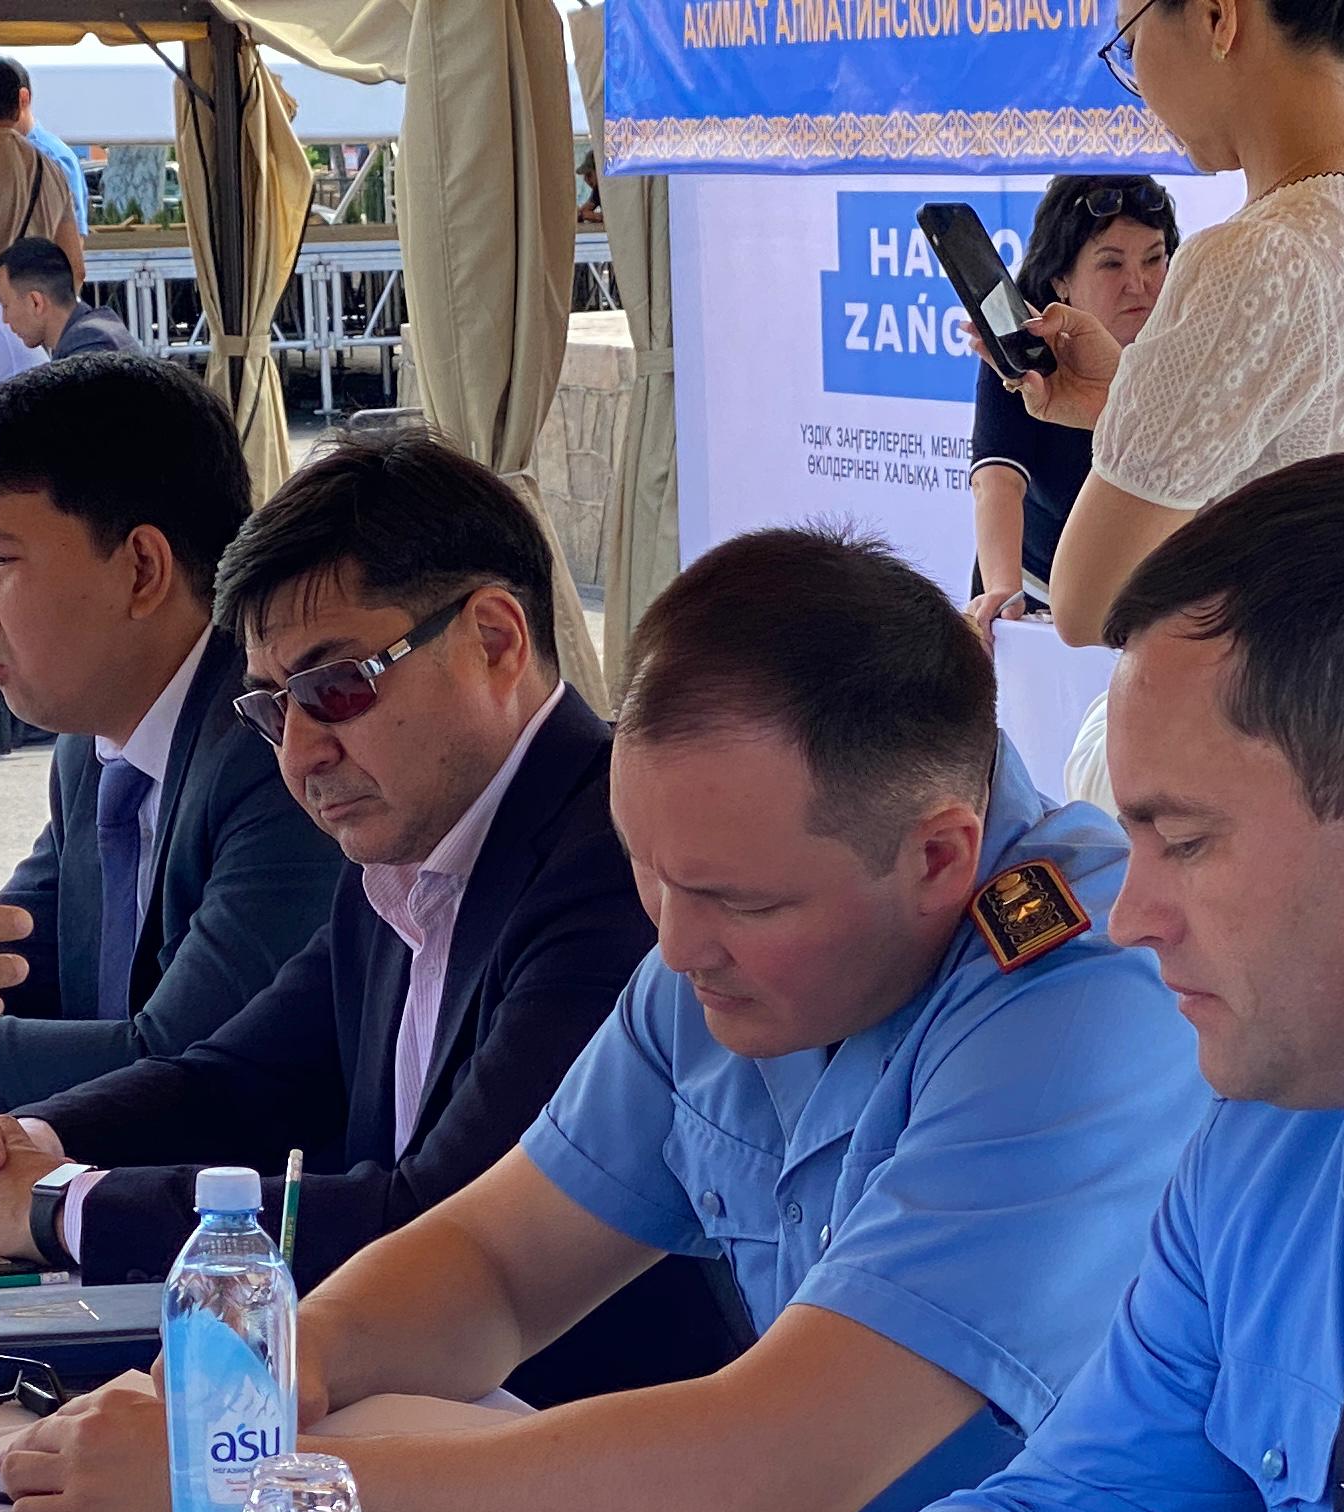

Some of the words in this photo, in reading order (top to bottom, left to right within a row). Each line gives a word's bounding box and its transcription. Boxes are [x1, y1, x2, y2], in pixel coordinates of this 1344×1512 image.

[682, 0, 768, 49] АКИМАТ
[844, 292, 974, 357] ZAŃG
[799, 423, 833, 450] ҮЗДІК
[884, 461, 940, 492] ХАЛЫҚҚА
